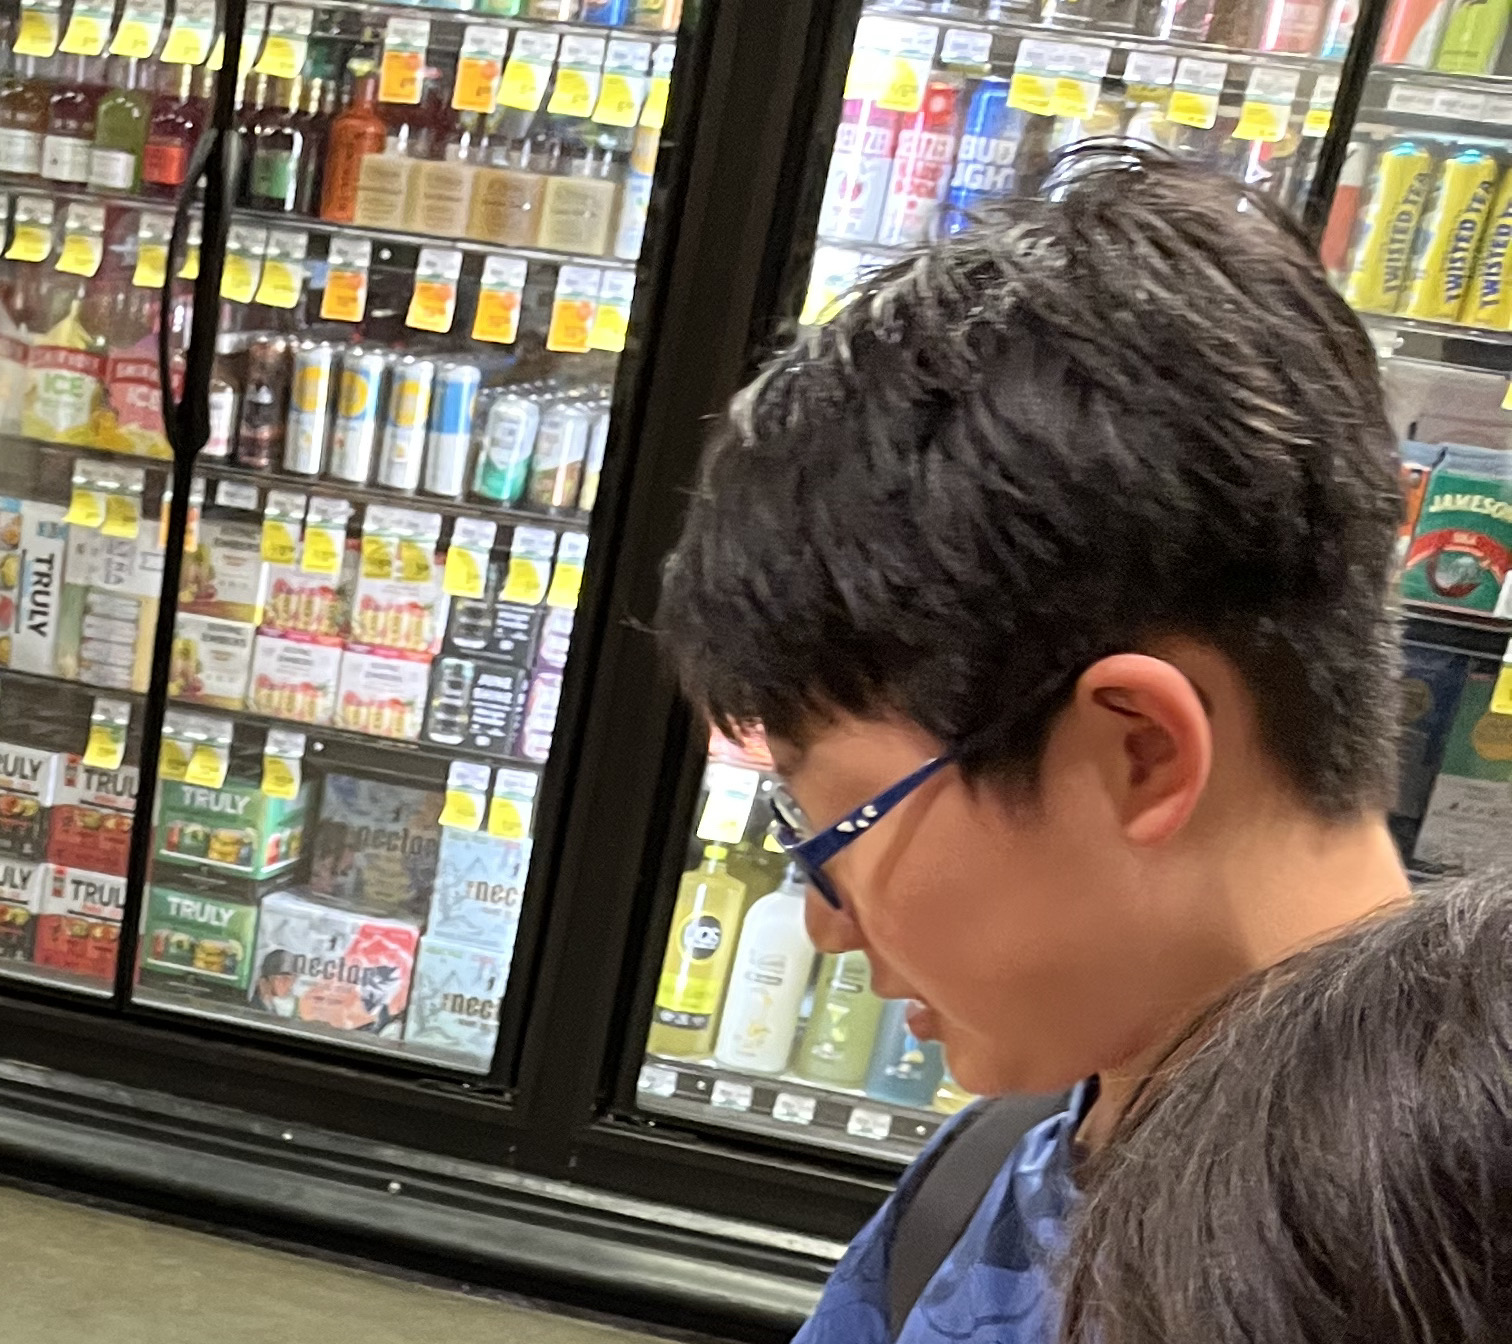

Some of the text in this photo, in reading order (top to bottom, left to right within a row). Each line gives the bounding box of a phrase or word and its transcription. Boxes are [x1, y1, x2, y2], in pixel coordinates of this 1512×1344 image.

[43, 373, 85, 398] ICE
[25, 552, 55, 639] TRULY
[180, 784, 252, 816] TRULY
[166, 896, 236, 928] TRULY
